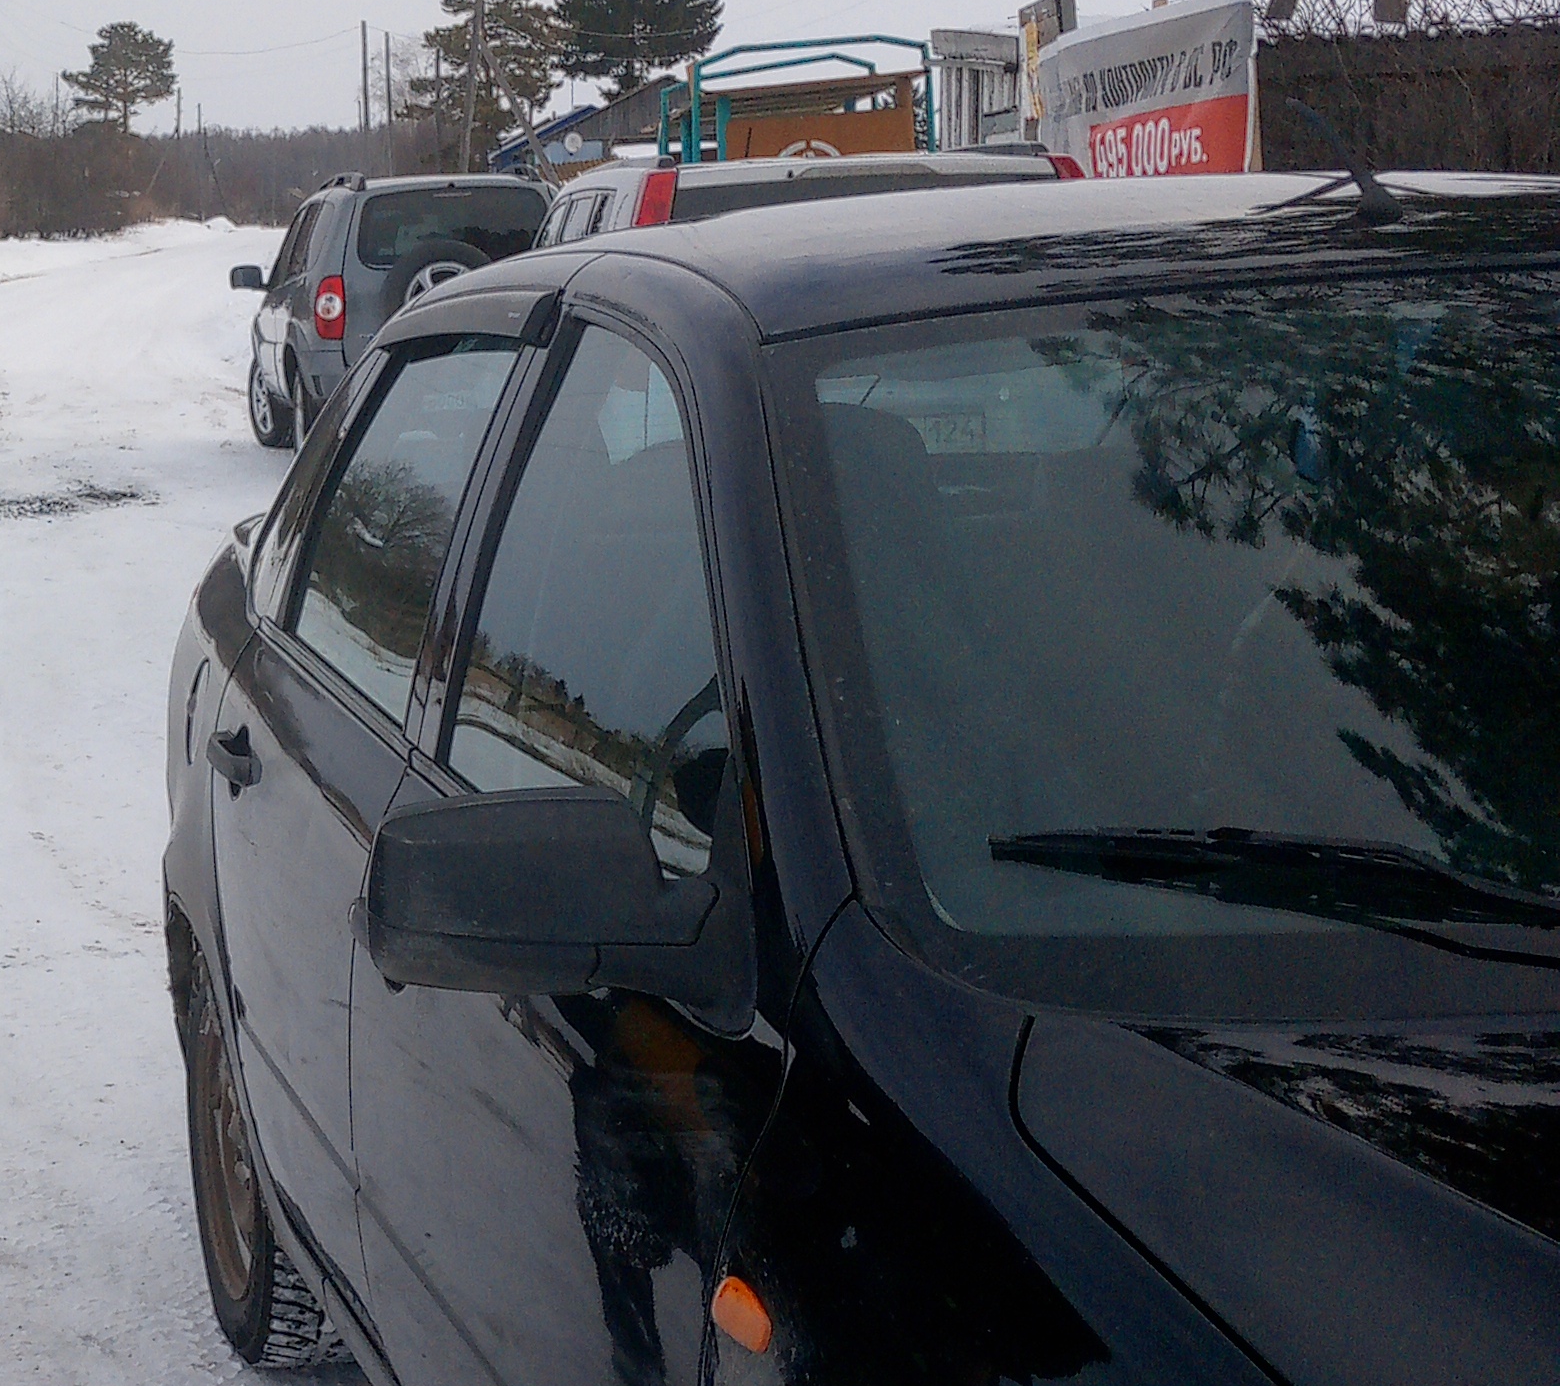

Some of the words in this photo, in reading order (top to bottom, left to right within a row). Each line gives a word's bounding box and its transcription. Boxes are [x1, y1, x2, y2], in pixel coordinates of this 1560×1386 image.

[1095, 126, 1129, 177] 495
[1131, 117, 1170, 176] 000
[1171, 127, 1209, 167] РУБ.
